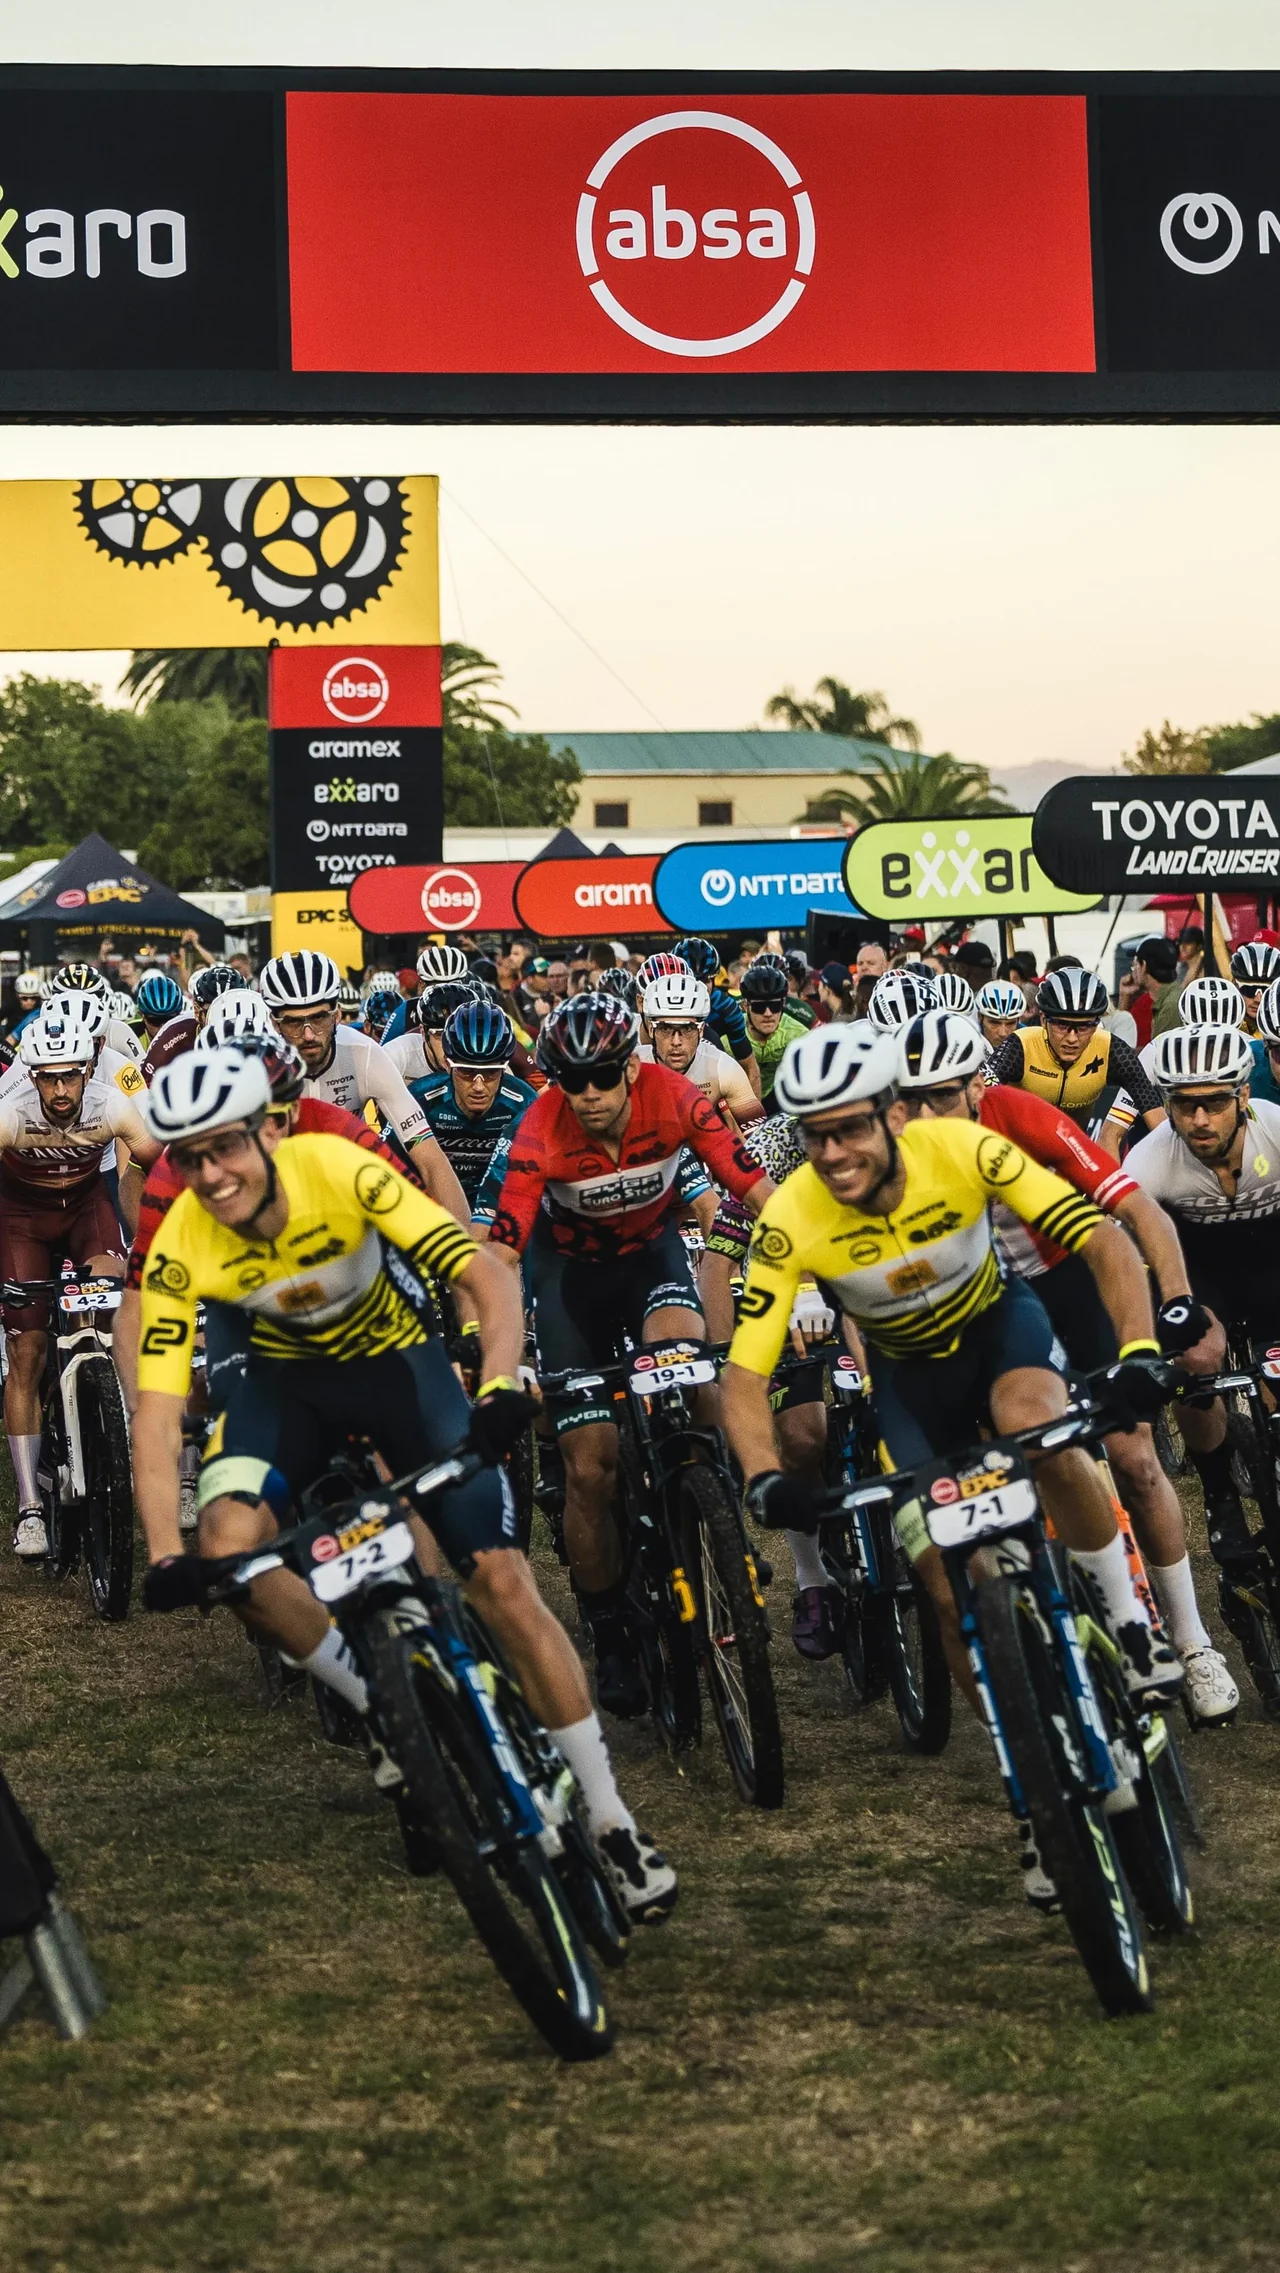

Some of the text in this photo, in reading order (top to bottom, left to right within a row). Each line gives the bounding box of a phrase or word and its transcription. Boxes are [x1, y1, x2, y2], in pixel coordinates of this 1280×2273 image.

[605, 184, 787, 260] absa
[330, 677, 381, 698] absa
[308, 740, 401, 758] aramex
[314, 777, 399, 802] exxaro
[332, 824, 363, 837] NTT
[1092, 799, 1279, 841] TOYOTA
[739, 874, 788, 897] NTT
[429, 886, 474, 908] absa
[297, 909, 335, 924] EPIC
[326, 1075, 355, 1087] TOYOTA
[1029, 1065, 1058, 1079] Bianchi
[583, 1173, 660, 1198] PYGA
[77, 1294, 108, 1306] 4-2
[81, 1286, 110, 1294] EPIC
[656, 1353, 695, 1367] EPIC
[649, 1365, 695, 1384] 19-1
[557, 1408, 611, 1431] PYGA
[960, 1467, 1008, 1498] EPIC
[961, 1495, 1003, 1526] 7-1
[339, 1542, 386, 1578] 7-2
